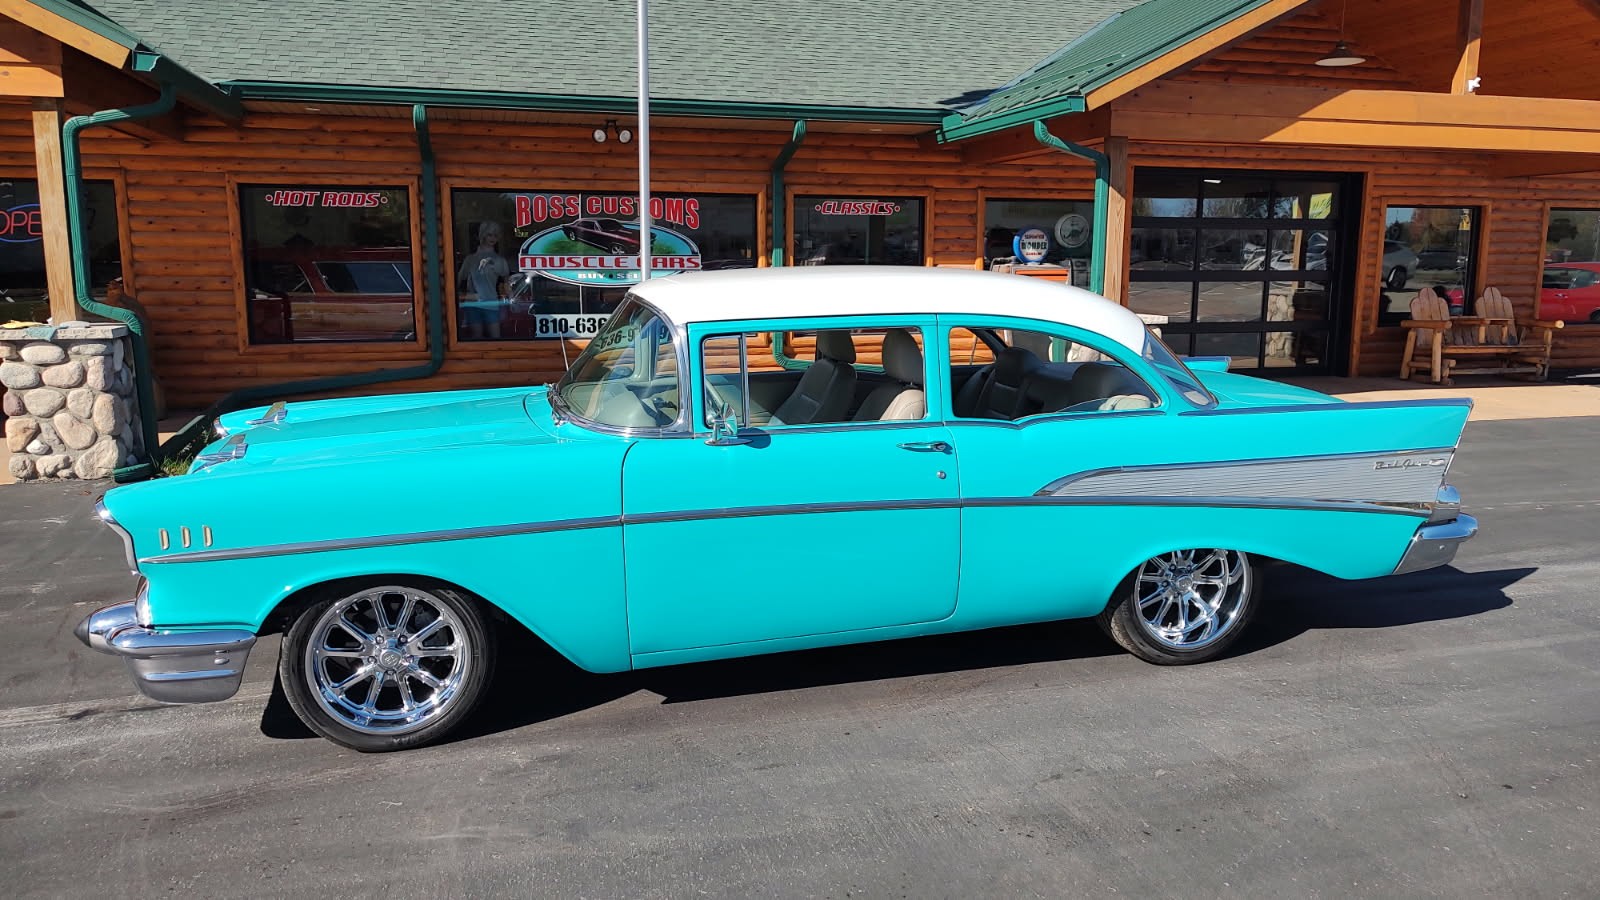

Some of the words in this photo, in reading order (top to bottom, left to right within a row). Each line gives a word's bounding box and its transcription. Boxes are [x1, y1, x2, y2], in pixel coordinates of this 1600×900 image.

[273, 191, 320, 206] HOT
[322, 192, 380, 207] RODS
[516, 195, 580, 228] ROSS
[821, 201, 895, 215] CLASSICS
[0, 211, 42, 235] OPE
[519, 256, 629, 268] MUSCLE
